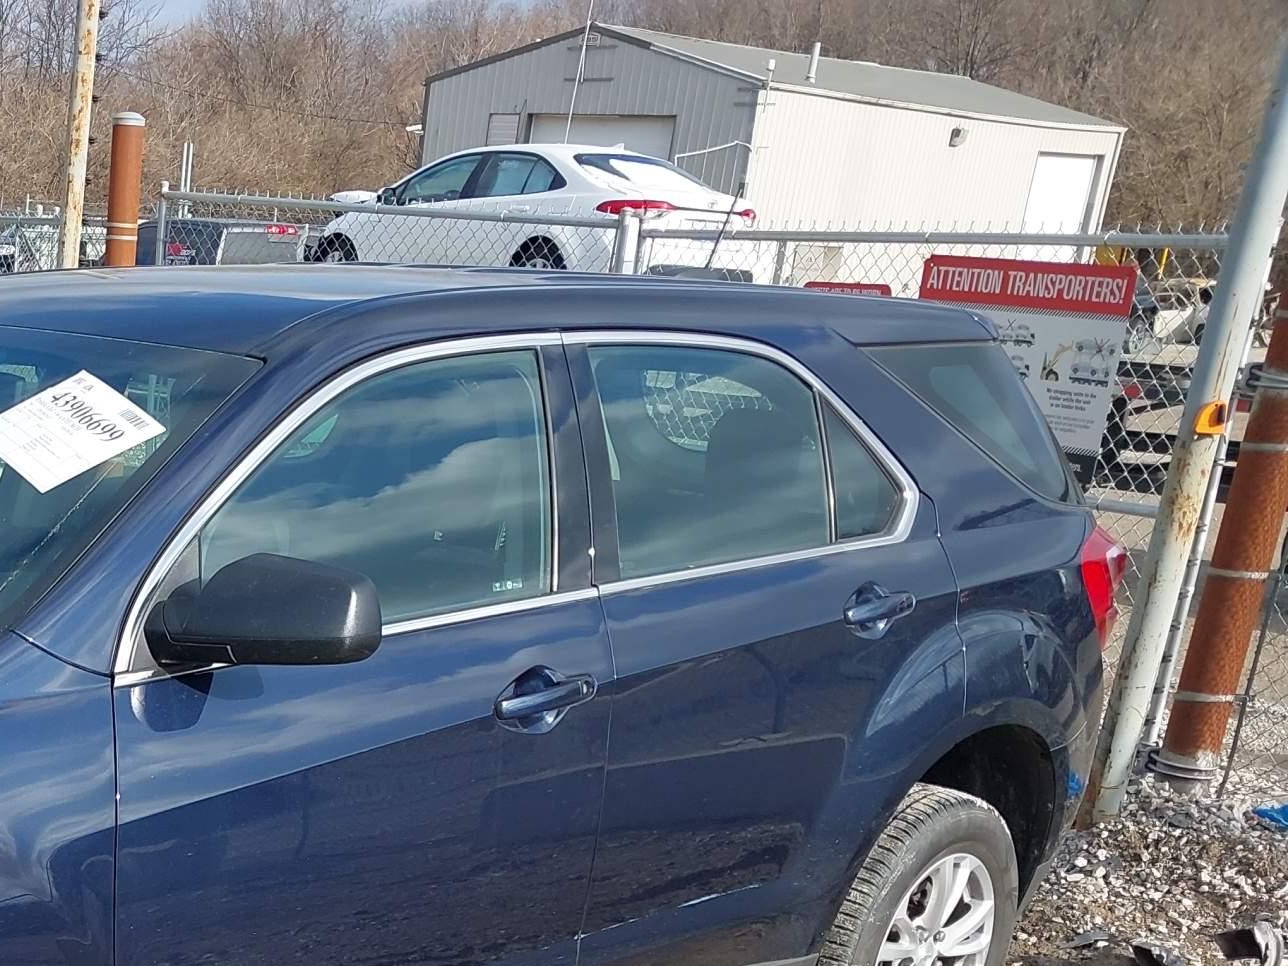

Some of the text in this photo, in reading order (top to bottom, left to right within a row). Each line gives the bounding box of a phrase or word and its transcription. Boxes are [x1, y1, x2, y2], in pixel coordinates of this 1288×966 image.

[927, 265, 1128, 304] ATTENTION TRANSPORTERS!
[50, 391, 125, 442] 43906699
